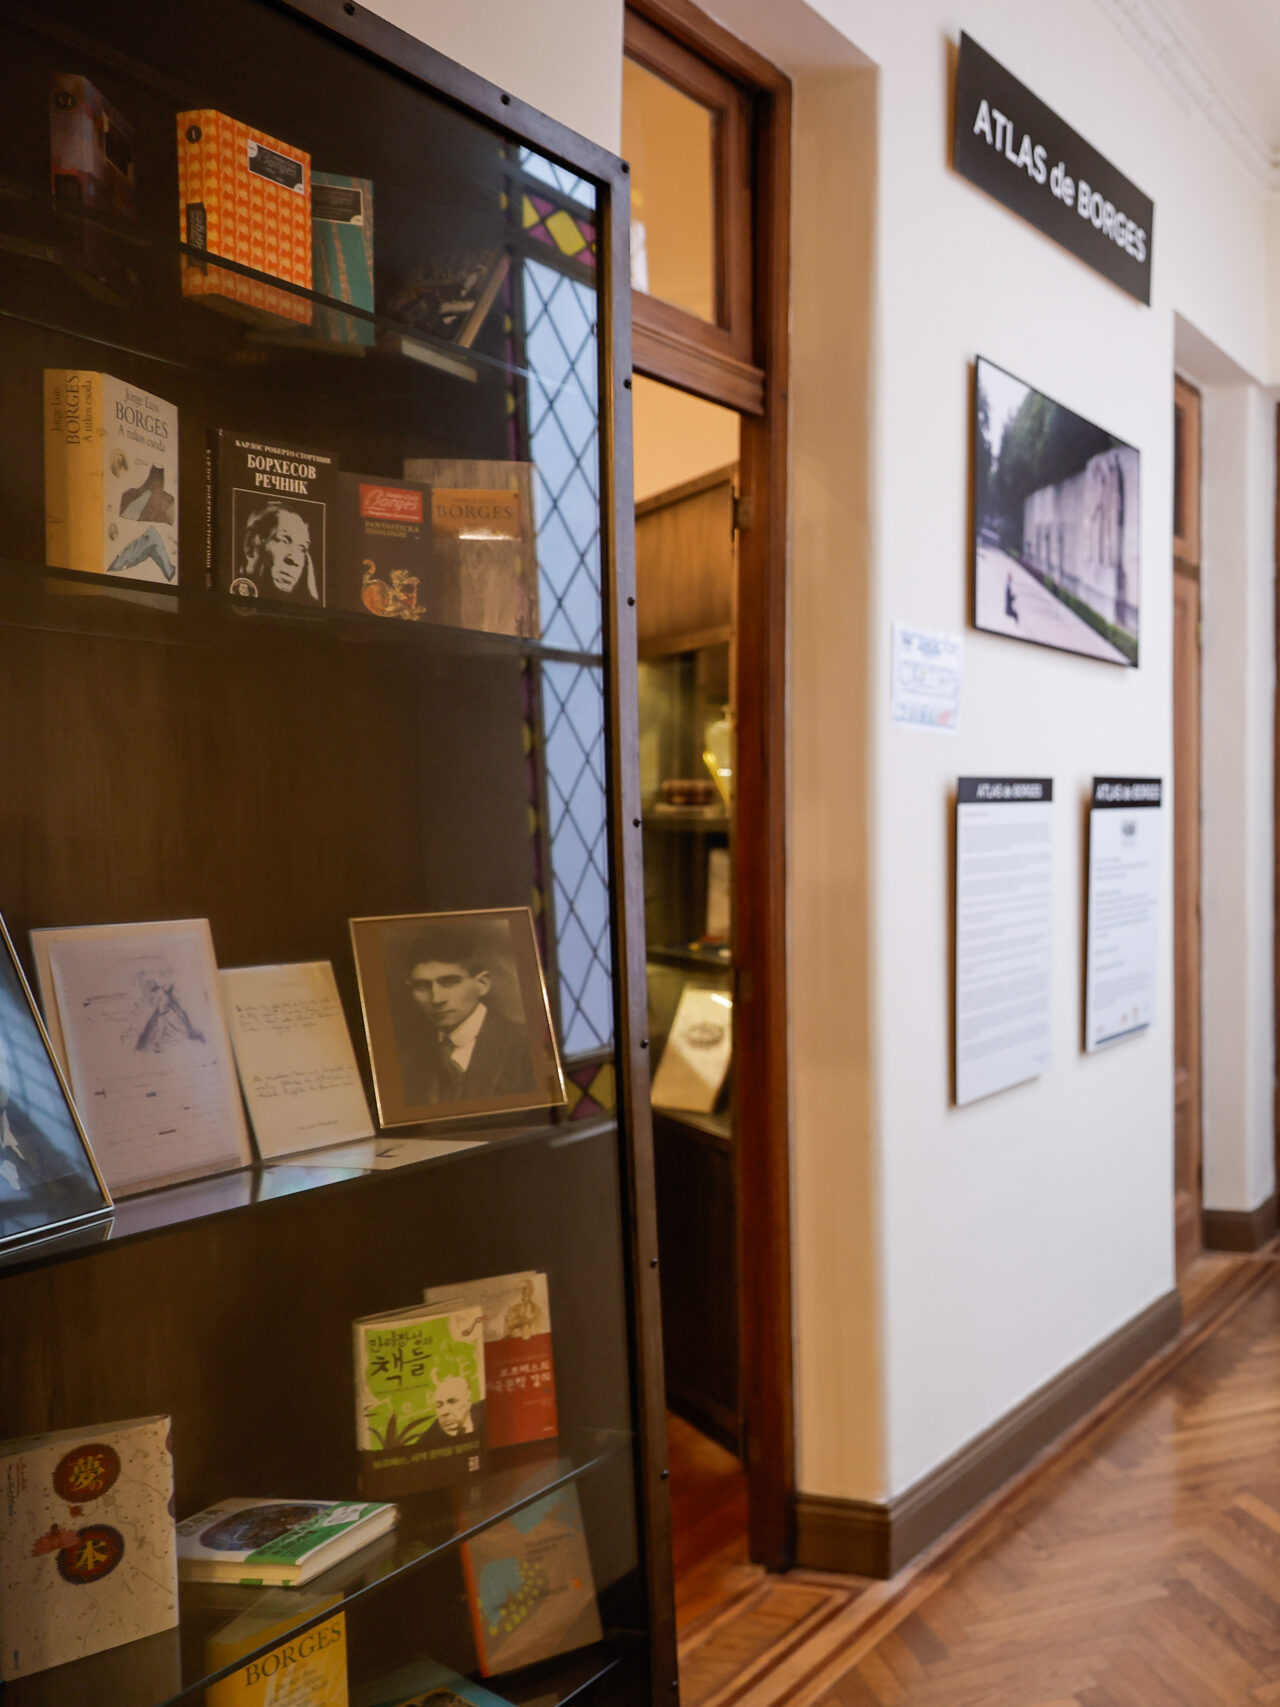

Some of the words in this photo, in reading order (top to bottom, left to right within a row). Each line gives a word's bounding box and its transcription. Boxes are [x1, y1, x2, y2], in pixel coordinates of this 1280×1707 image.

[973, 99, 1046, 184] ATLAS
[1050, 161, 1075, 206] de
[1077, 179, 1146, 263] BORGES
[65, 375, 80, 444] BORGES
[115, 401, 168, 439] BORGES
[247, 453, 317, 480] БОРХЕСОВ
[255, 472, 309, 495] РЕЧНИК
[436, 504, 513, 520] BORGES
[370, 1347, 432, 1386] 책들
[75, 1541, 108, 1570] 本
[245, 1622, 342, 1687] BORGES
